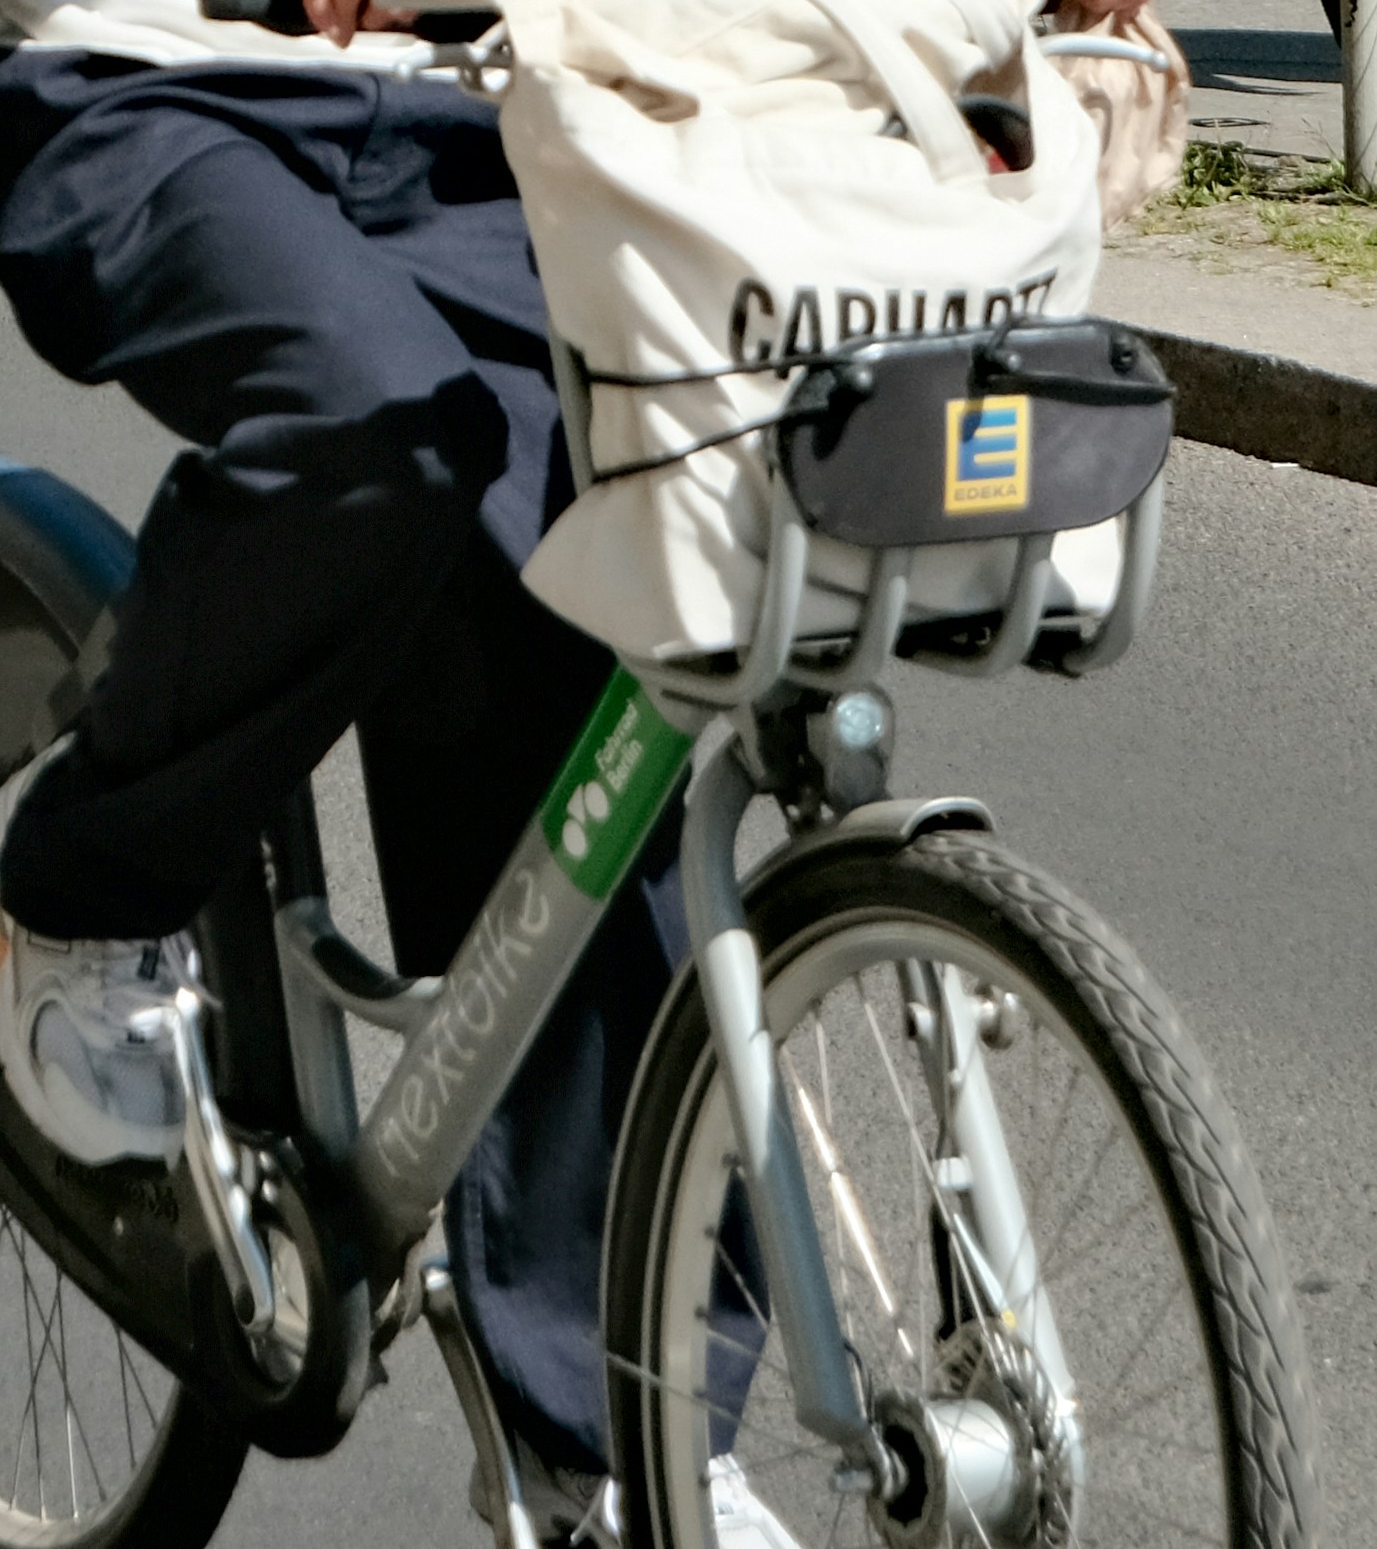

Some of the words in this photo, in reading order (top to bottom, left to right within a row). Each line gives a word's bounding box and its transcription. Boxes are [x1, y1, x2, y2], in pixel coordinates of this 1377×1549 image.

[954, 483, 1018, 502] EDEKA
[605, 738, 644, 794] Berlin
[374, 865, 551, 1178] nextbike
